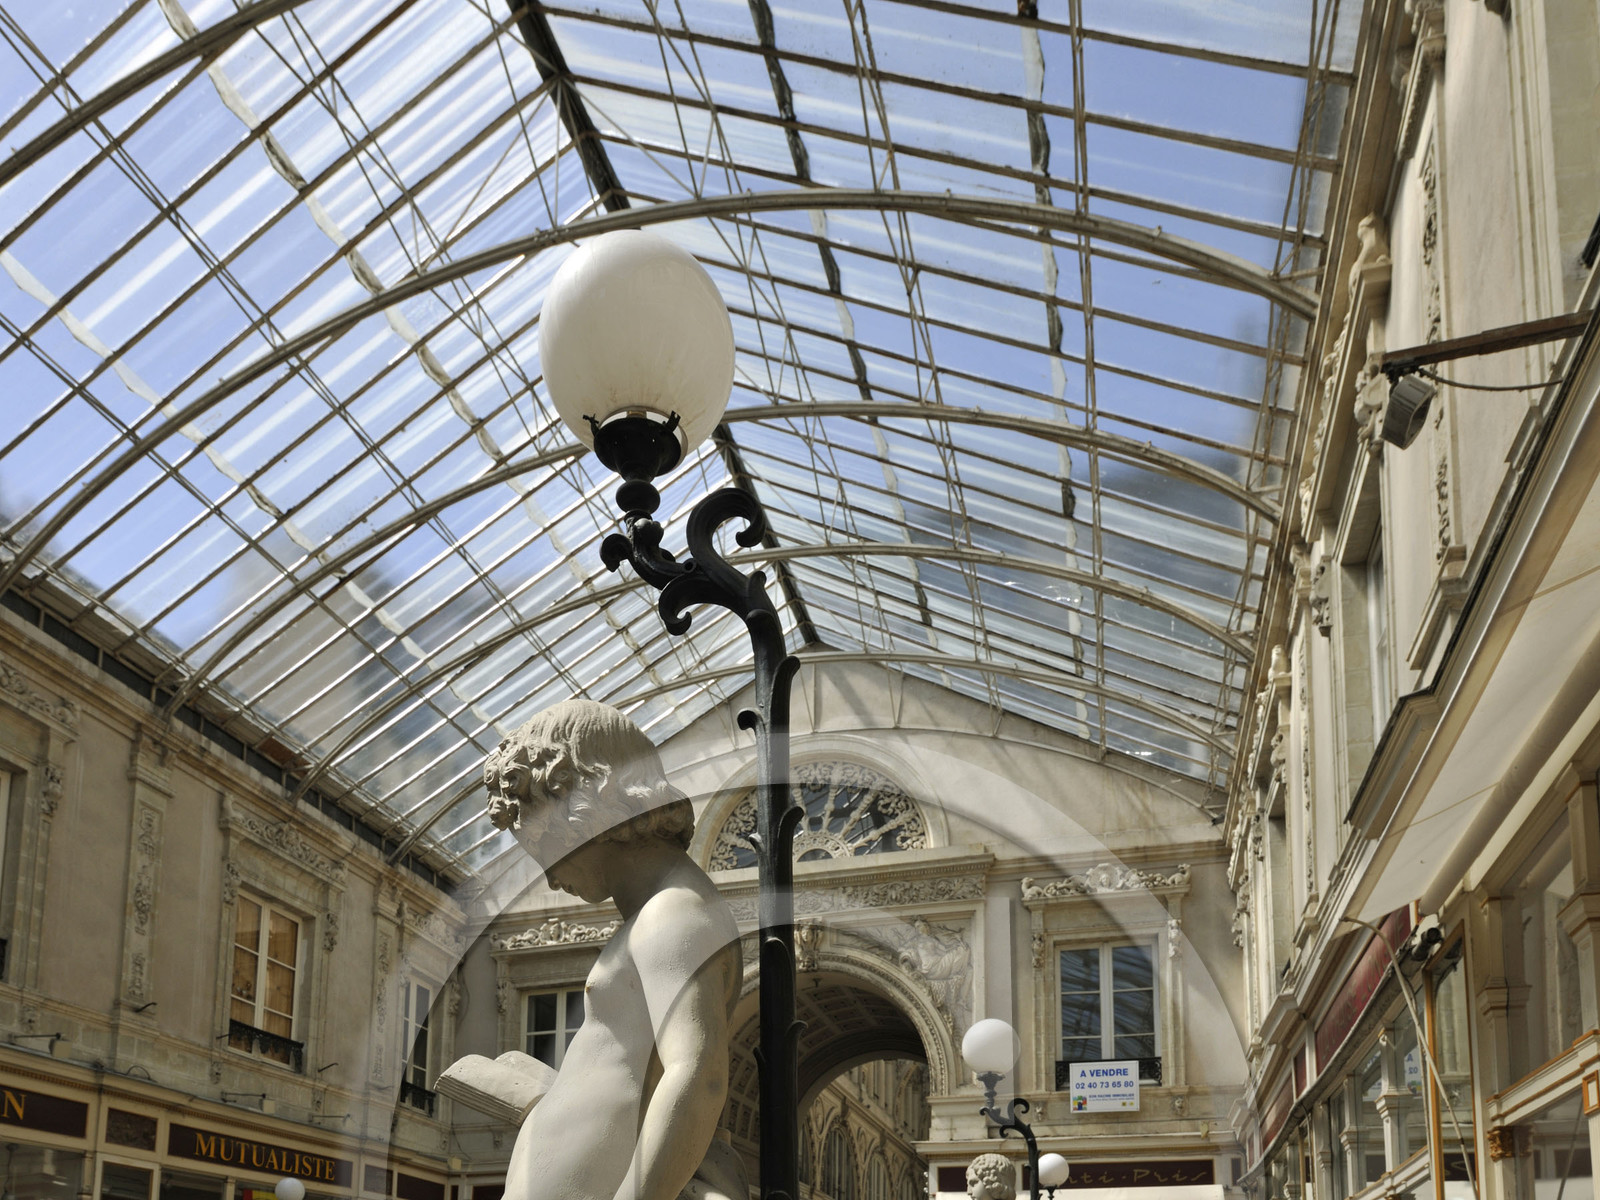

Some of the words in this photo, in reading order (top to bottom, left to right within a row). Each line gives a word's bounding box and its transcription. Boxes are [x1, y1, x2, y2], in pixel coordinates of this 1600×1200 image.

[1089, 1068, 1129, 1077] VENDRE
[1124, 1080, 1134, 1088] 80
[194, 1132, 335, 1181] MUTUALISTE
